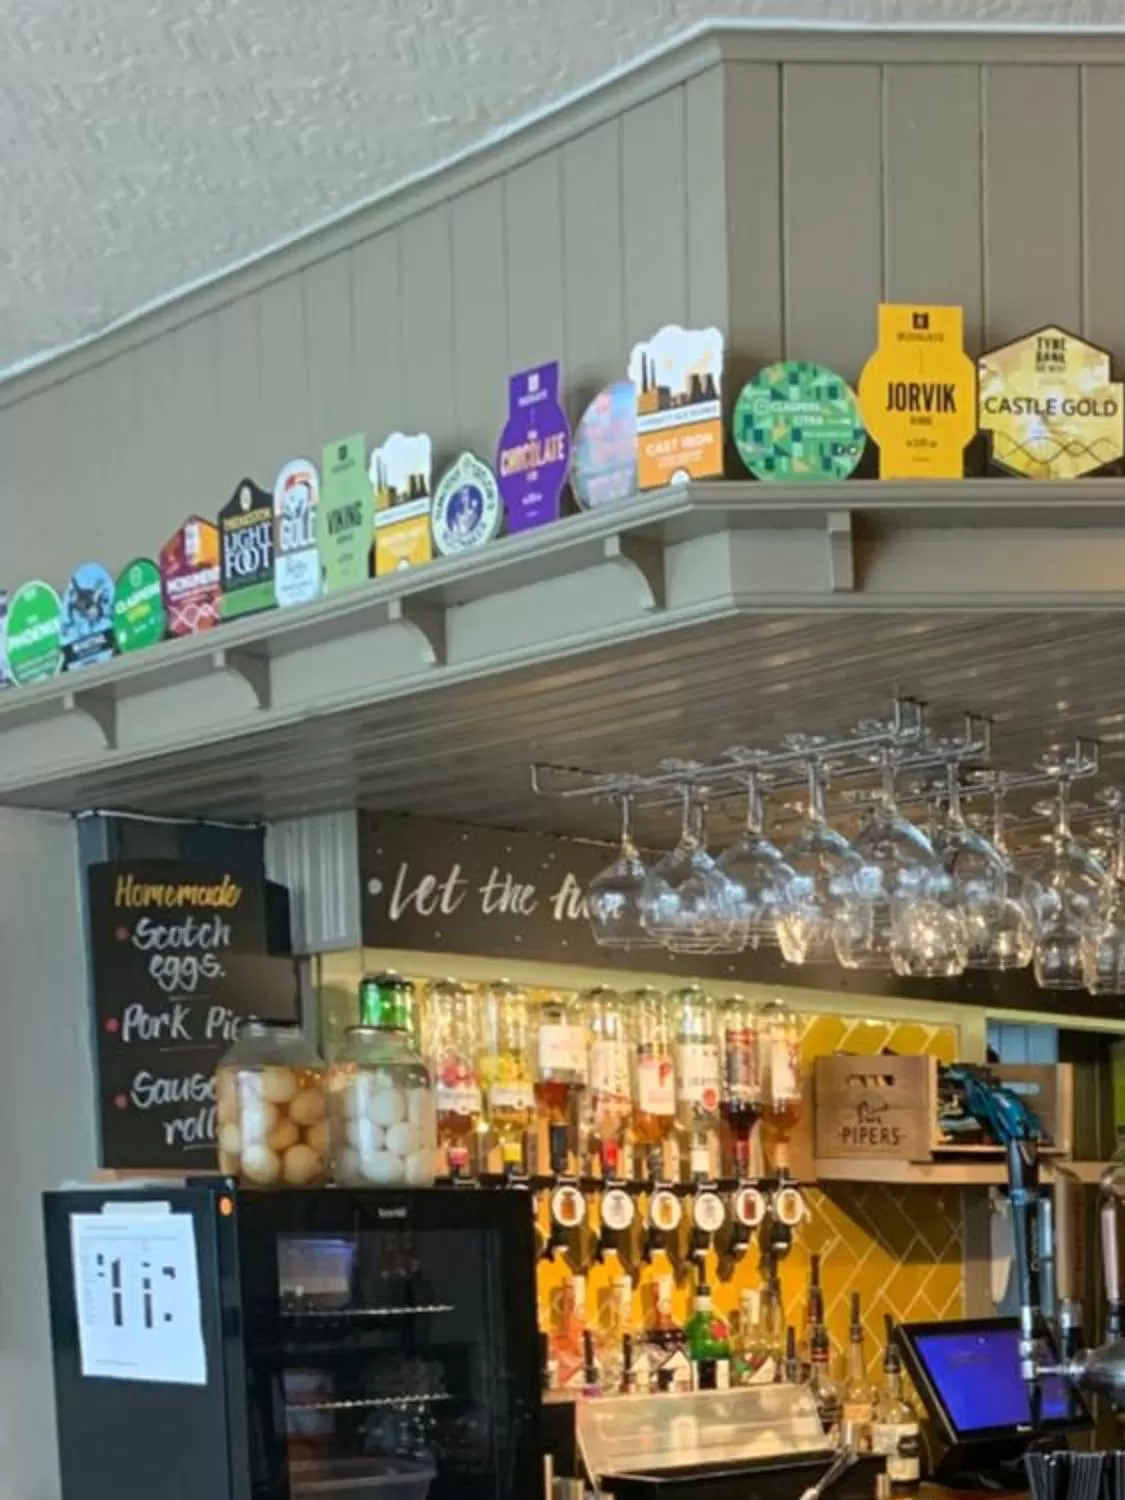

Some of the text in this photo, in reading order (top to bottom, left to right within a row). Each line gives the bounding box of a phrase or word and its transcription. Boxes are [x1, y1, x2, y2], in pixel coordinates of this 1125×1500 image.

[886, 381, 957, 414] JORVIK
[984, 397, 1118, 417] CASTLE GOLD
[501, 432, 566, 477] CHOCOLATE
[223, 522, 273, 552] LIGHT
[224, 542, 272, 579] FOOT
[115, 874, 242, 908] Homemade
[479, 866, 540, 915] the
[132, 915, 231, 949] Scotch
[842, 1126, 901, 1146] PIPERS
